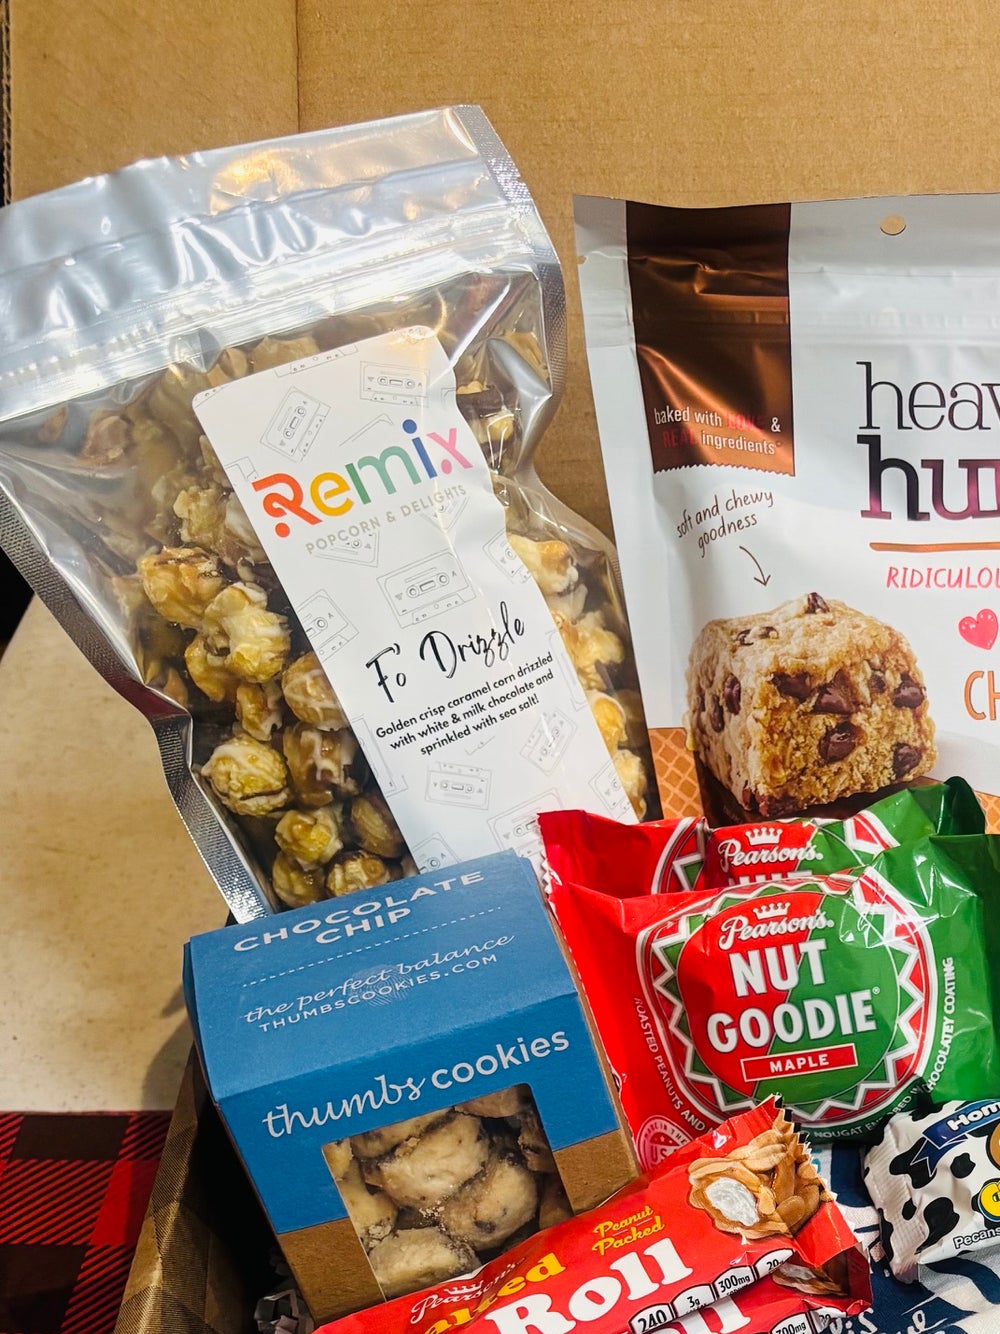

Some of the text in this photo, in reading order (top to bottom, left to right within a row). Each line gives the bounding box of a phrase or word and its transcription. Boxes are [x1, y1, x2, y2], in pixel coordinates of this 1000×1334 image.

[654, 405, 690, 425] baked
[694, 411, 722, 427] with
[253, 419, 473, 538] Remix
[695, 489, 773, 524] and chewy
[306, 485, 467, 556] POPCORN DELIGHTS
[698, 513, 757, 558] goodness
[419, 601, 524, 679] Drizzle
[376, 652, 553, 738] Golden crisp caramel corn drizzled
[390, 669, 554, 750] with white & milk chocolate and
[420, 694, 539, 755] sprinkled with sea salt!
[718, 835, 823, 872] Pearson's
[233, 871, 485, 952] CHOCOLATE
[315, 908, 412, 944] CHIP
[720, 903, 833, 951] Pearson's
[244, 934, 515, 1024] the perfect balance
[258, 954, 498, 1033] THUMBSCOOKIES.COM
[728, 939, 827, 998] NUT
[943, 957, 955, 1014] COATING
[707, 989, 877, 1054] GOODIE
[262, 1029, 569, 1138] thumbs cookies
[655, 1056, 683, 1110] PEANUTS
[681, 1110, 705, 1130] AND
[769, 1054, 829, 1073] MAPLE
[592, 1221, 665, 1256] Packed
[594, 1206, 654, 1239] Peanut
[718, 1274, 751, 1292] 300mg
